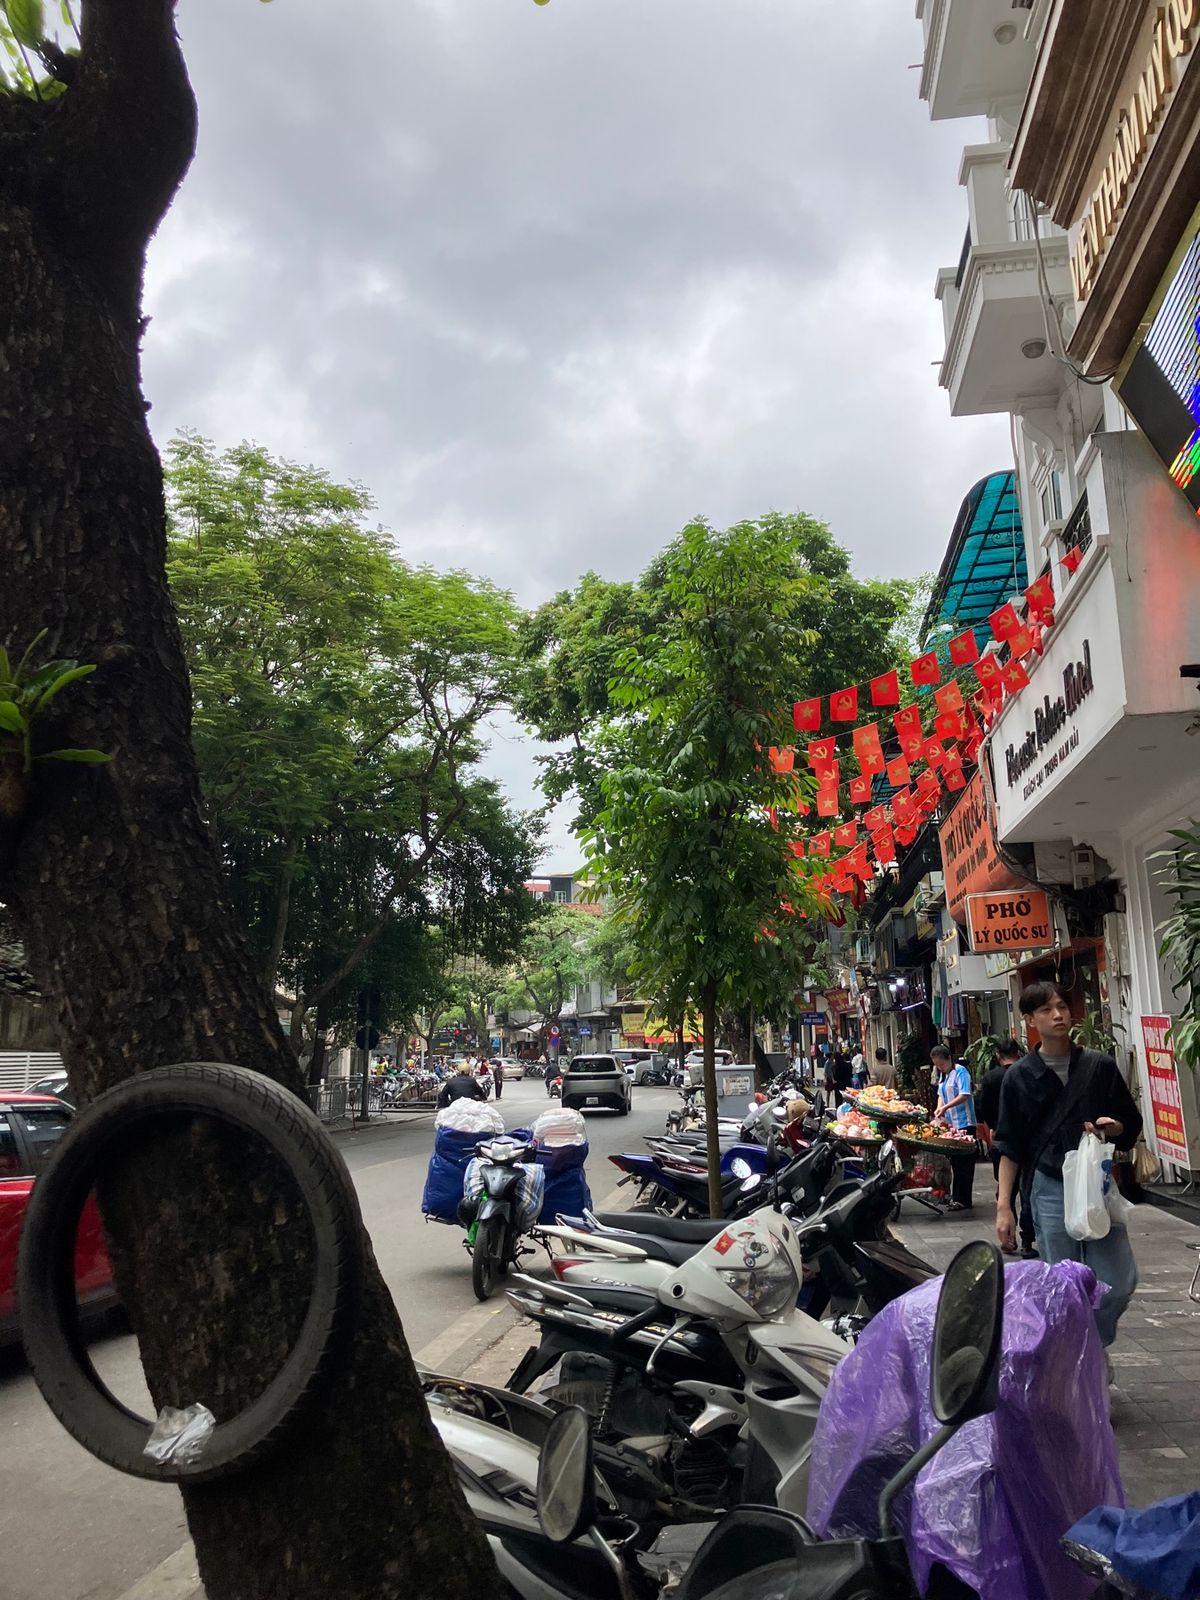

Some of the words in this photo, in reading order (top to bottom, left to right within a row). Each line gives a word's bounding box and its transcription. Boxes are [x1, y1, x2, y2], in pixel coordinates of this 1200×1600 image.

[1063, 639, 1094, 717] Hotel
[985, 895, 1032, 920] PHỞ
[975, 926, 991, 944] LÝ
[993, 921, 1028, 945] QUỐC
[1031, 923, 1049, 939] SƯ
